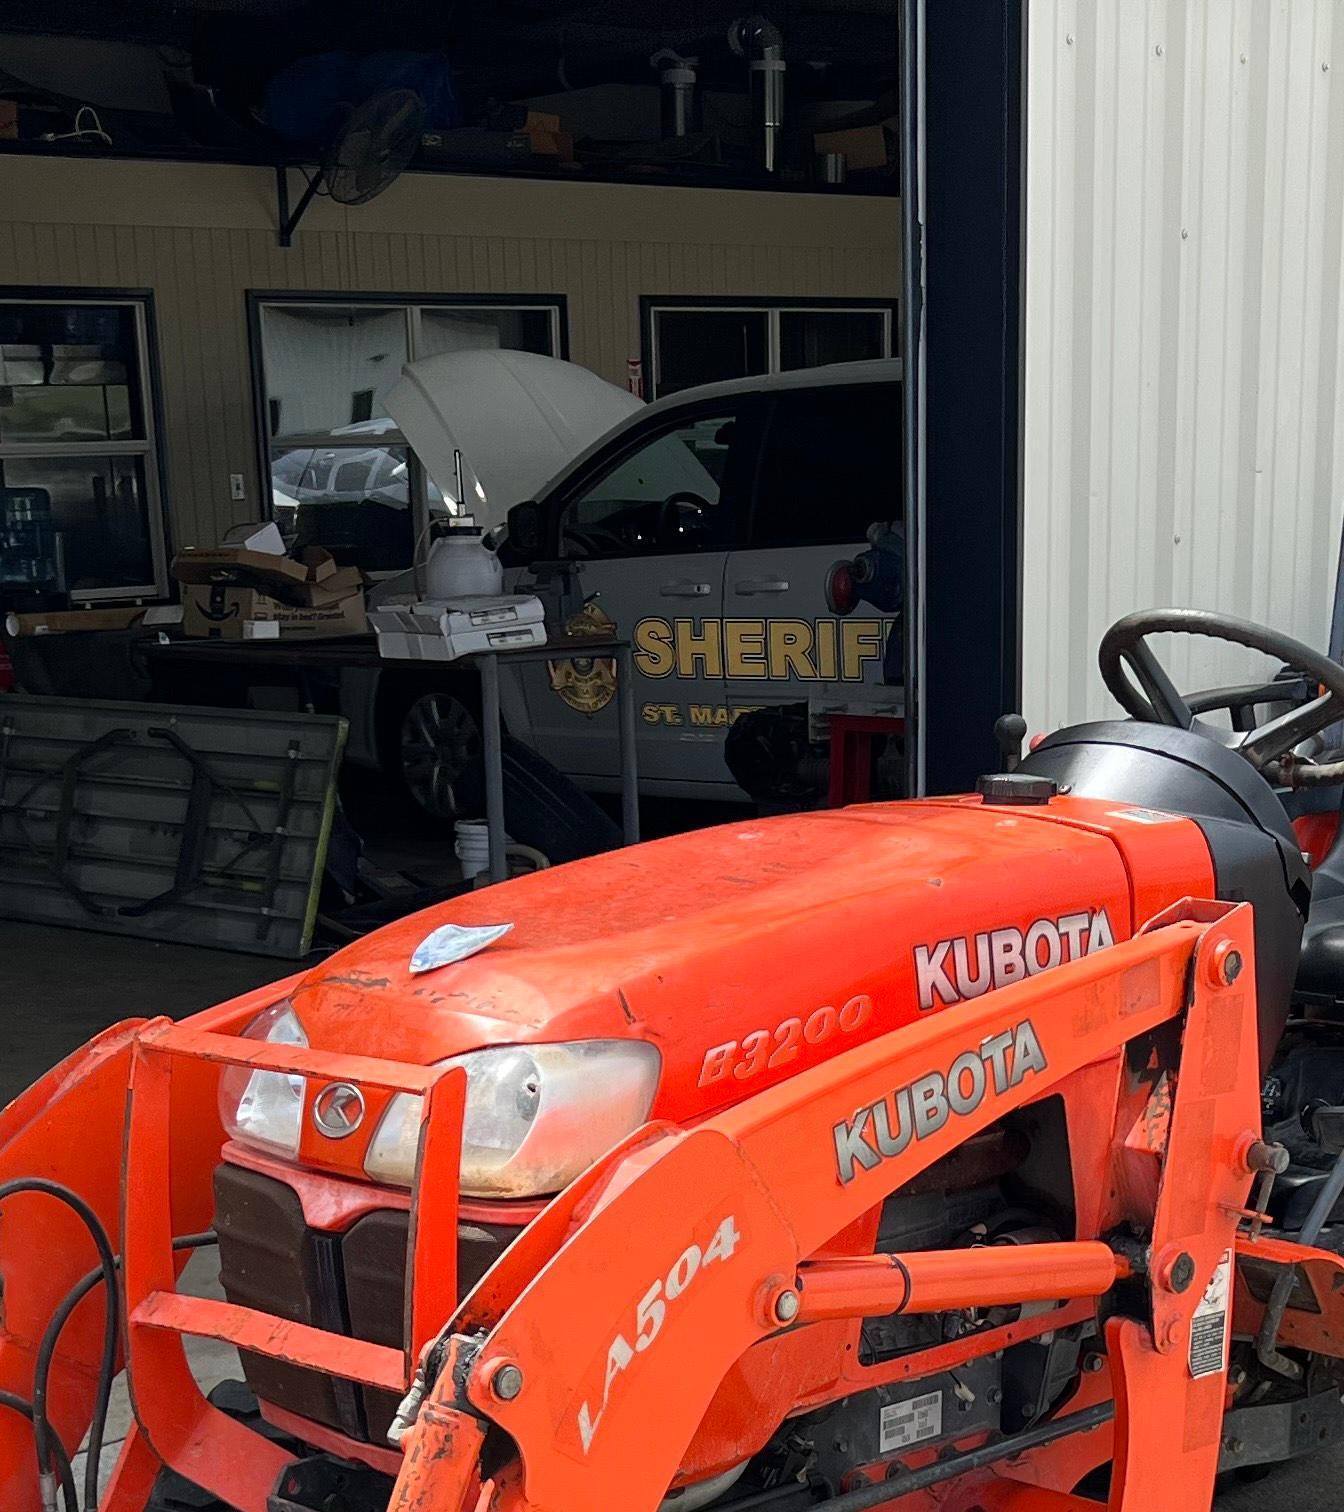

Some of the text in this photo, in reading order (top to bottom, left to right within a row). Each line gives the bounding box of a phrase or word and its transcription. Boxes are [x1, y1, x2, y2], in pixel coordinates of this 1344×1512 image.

[633, 616, 896, 683] SHERIF
[641, 702, 683, 727] ST.
[912, 905, 1116, 1010] KUBOTA
[696, 993, 874, 1088] B3200
[831, 1018, 1048, 1186] KUBOTA
[577, 1215, 741, 1456] LA504
